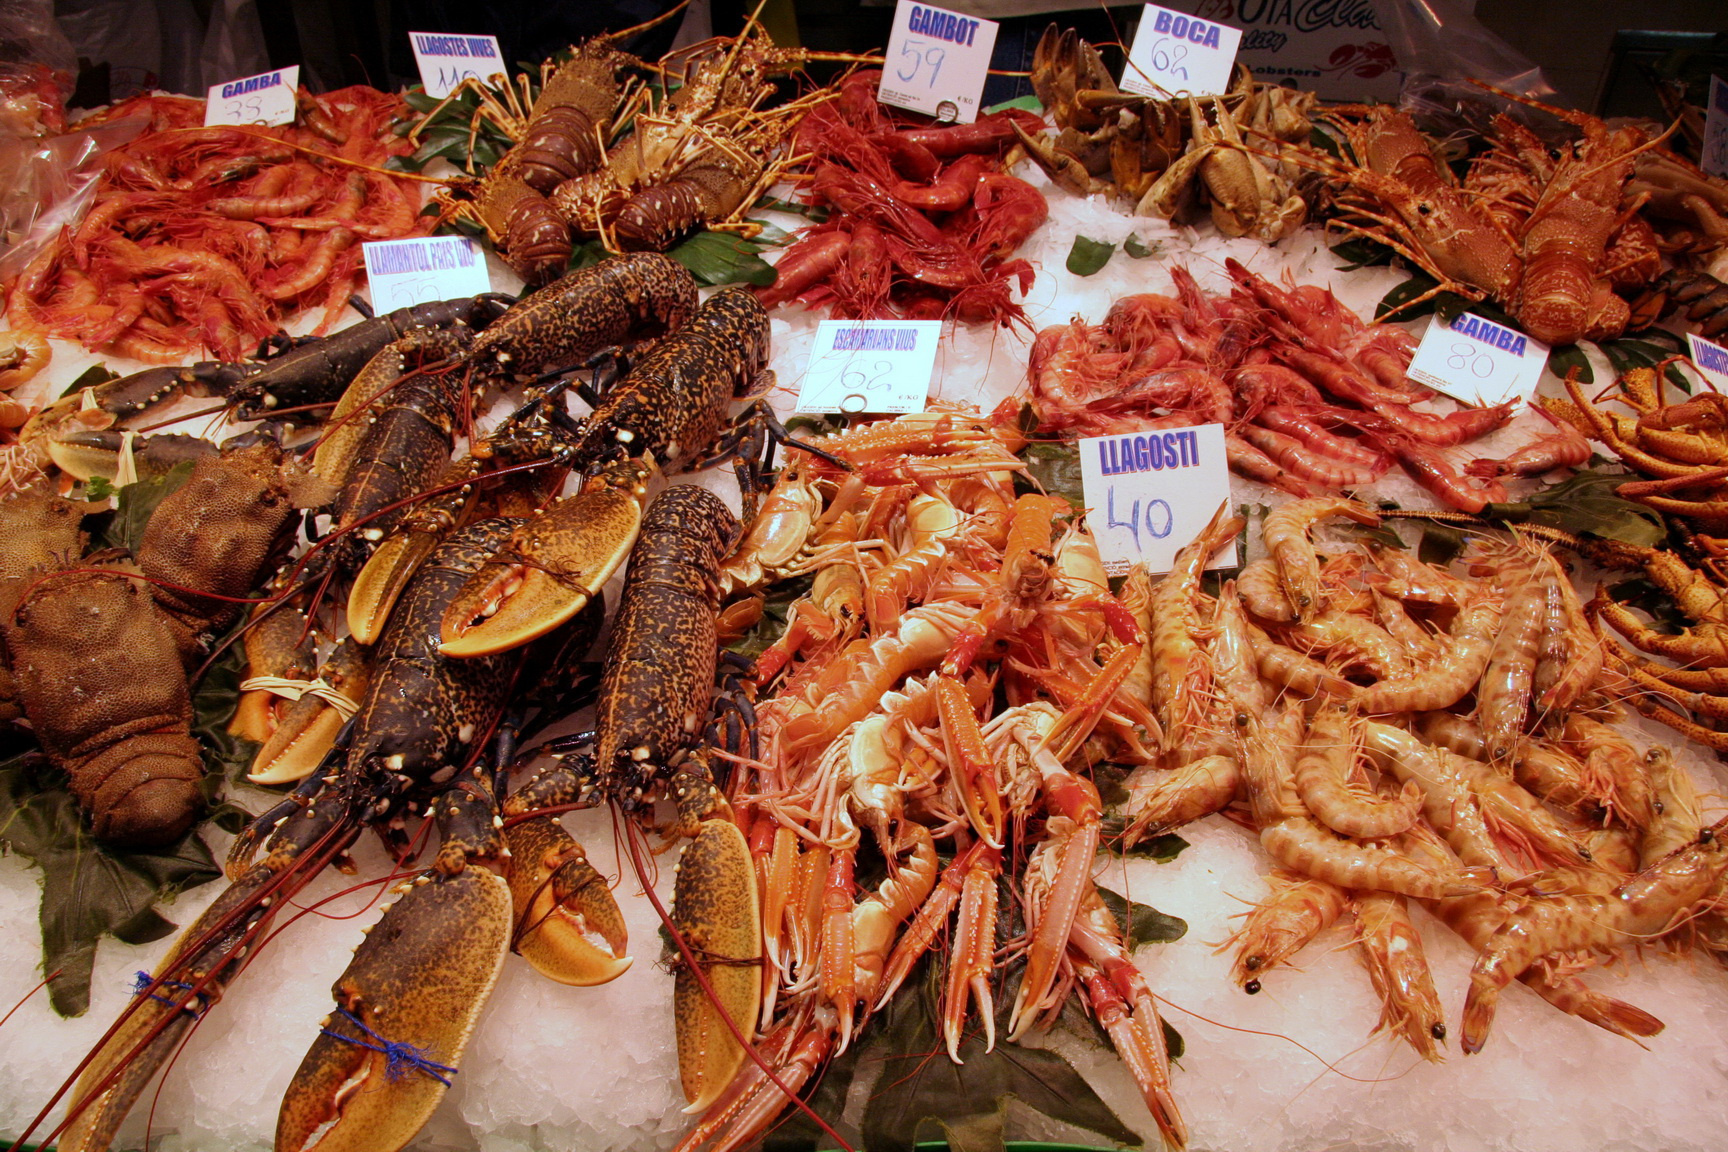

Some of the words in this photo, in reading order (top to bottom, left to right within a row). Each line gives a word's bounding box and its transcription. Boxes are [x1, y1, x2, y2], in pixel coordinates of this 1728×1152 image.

[415, 35, 470, 58] LLAGOSTES
[466, 37, 497, 59] VIVES
[908, 5, 980, 48] GAMBOT
[1153, 10, 1221, 51] BOCA
[896, 38, 946, 89] 59
[1151, 37, 1188, 81] 62
[222, 72, 283, 99] GAMBA
[368, 243, 432, 275] LLAMANTOL
[832, 328, 897, 352] ESCAMARLANS
[895, 328, 919, 352] VIUS
[1449, 312, 1528, 358] GAMBA
[840, 359, 893, 392] 62
[1447, 342, 1495, 379] 80
[1098, 430, 1200, 477] LLAGOSTI
[1107, 485, 1173, 552] 40
